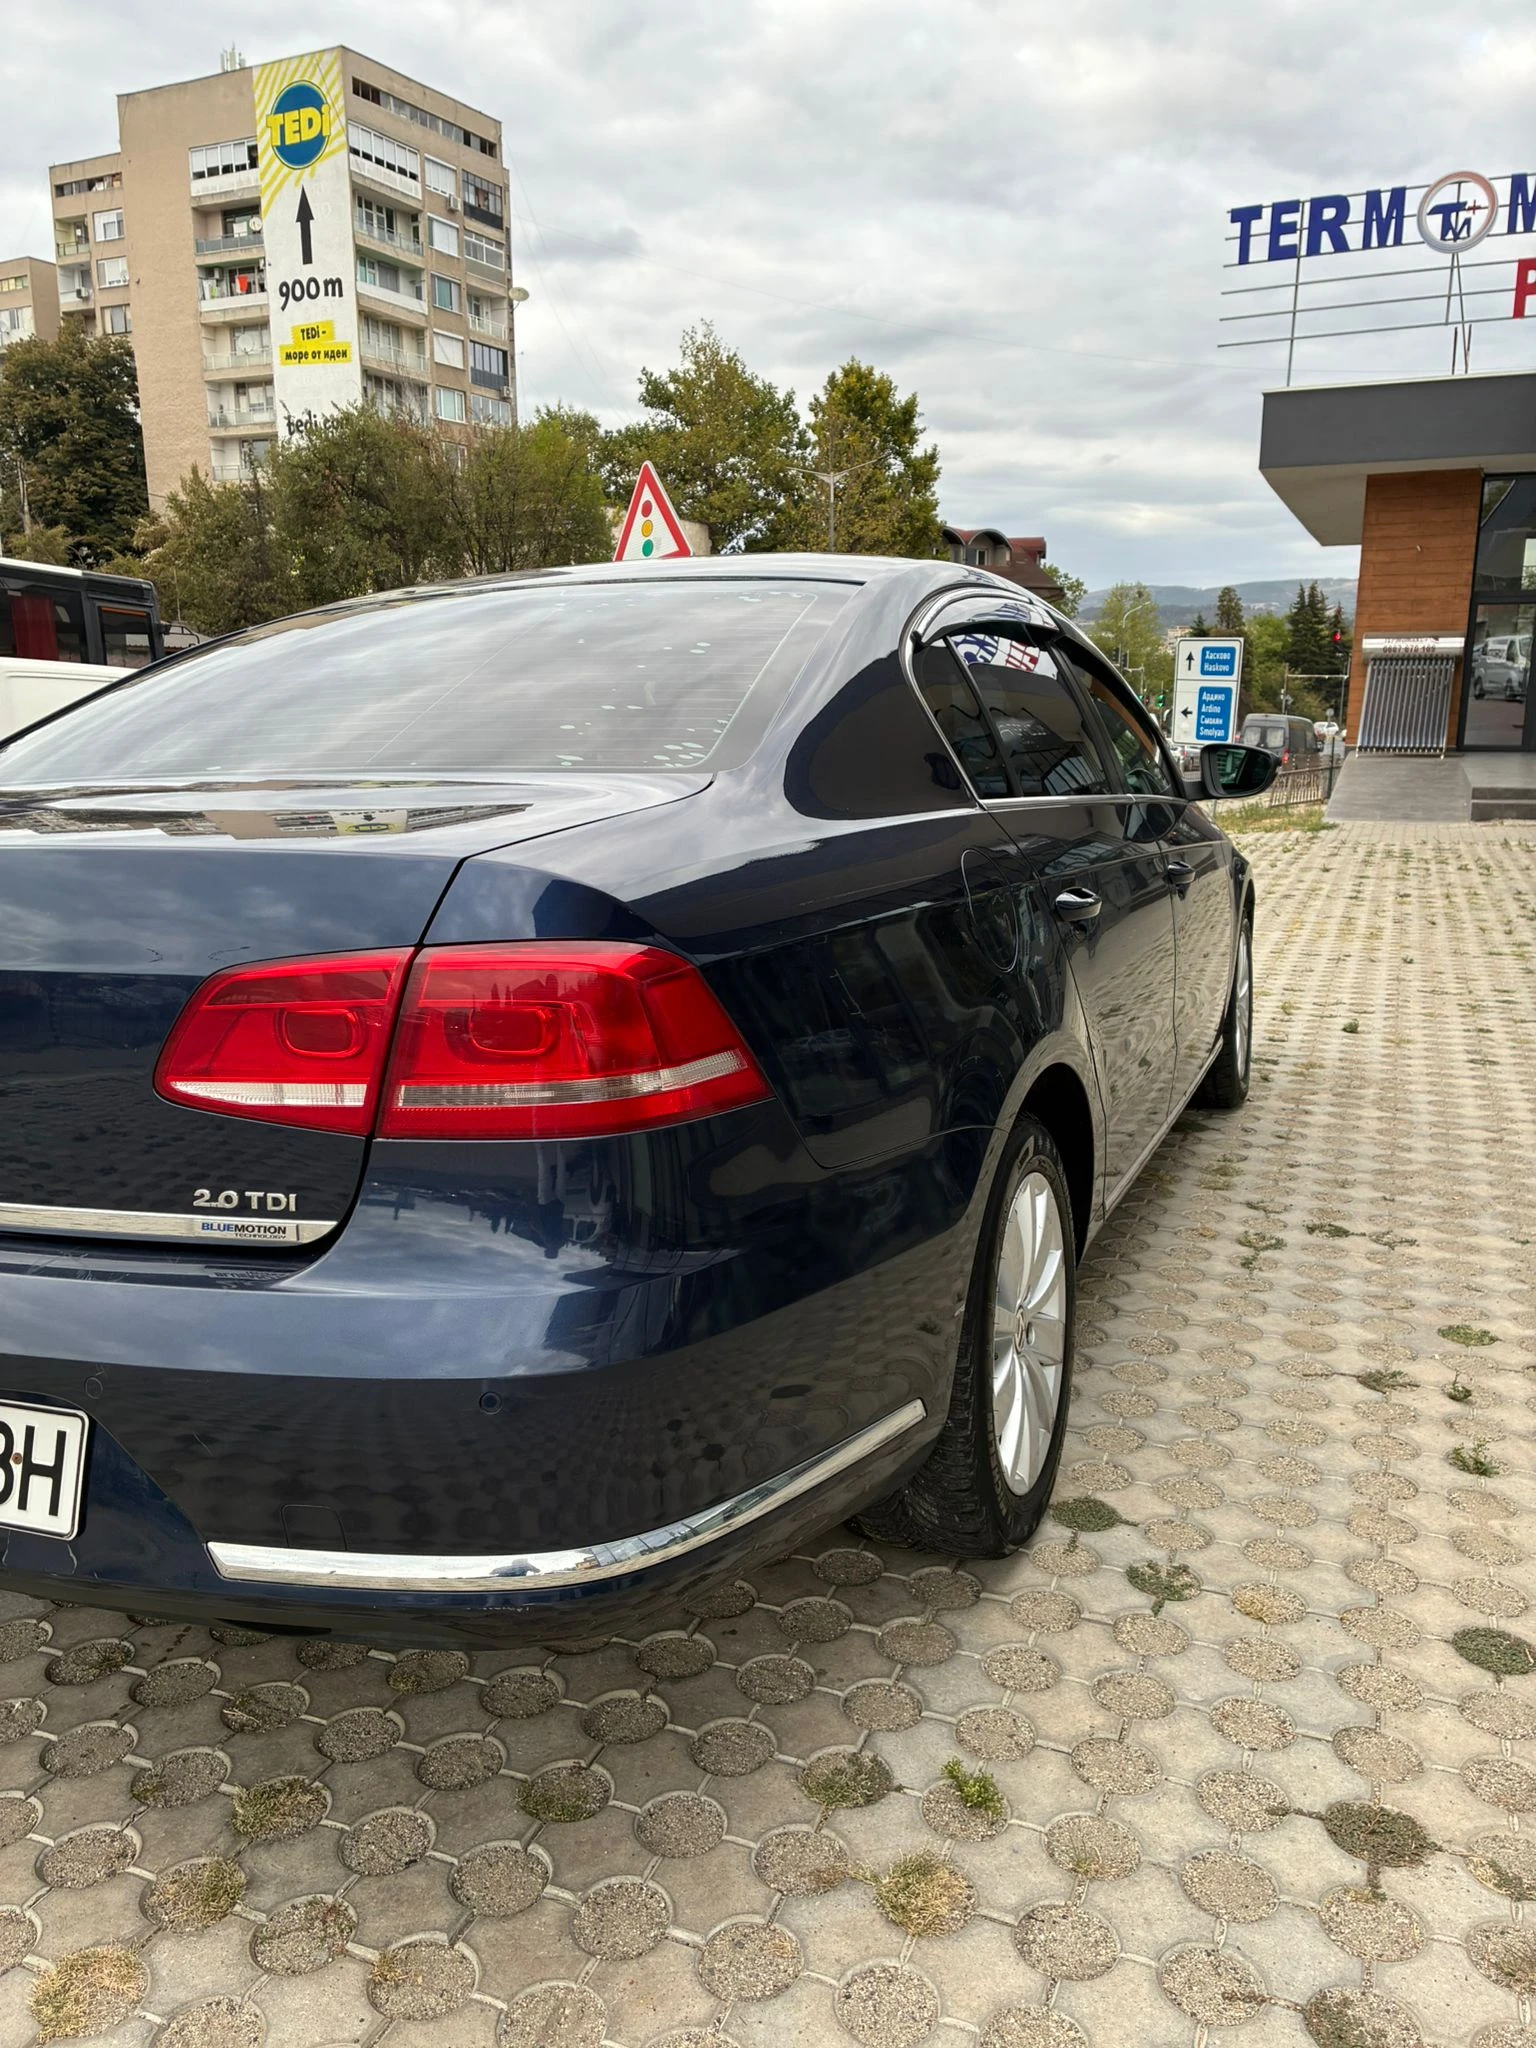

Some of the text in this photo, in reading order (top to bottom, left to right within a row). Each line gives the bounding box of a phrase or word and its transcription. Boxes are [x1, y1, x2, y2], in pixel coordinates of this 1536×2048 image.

[266, 103, 331, 148] TEDi
[279, 276, 343, 312] 900 m
[300, 325, 320, 341] TEDi
[285, 347, 348, 364] море от идеи
[1205, 650, 1231, 660] Хасково
[1204, 662, 1229, 672] Haskovo
[1202, 691, 1226, 702] Ардино
[1201, 704, 1221, 713] Ardino
[1199, 726, 1225, 738] Smolyan
[193, 1188, 297, 1212] 2.0 TDI
[201, 1222, 287, 1235] BLUEMOTION
